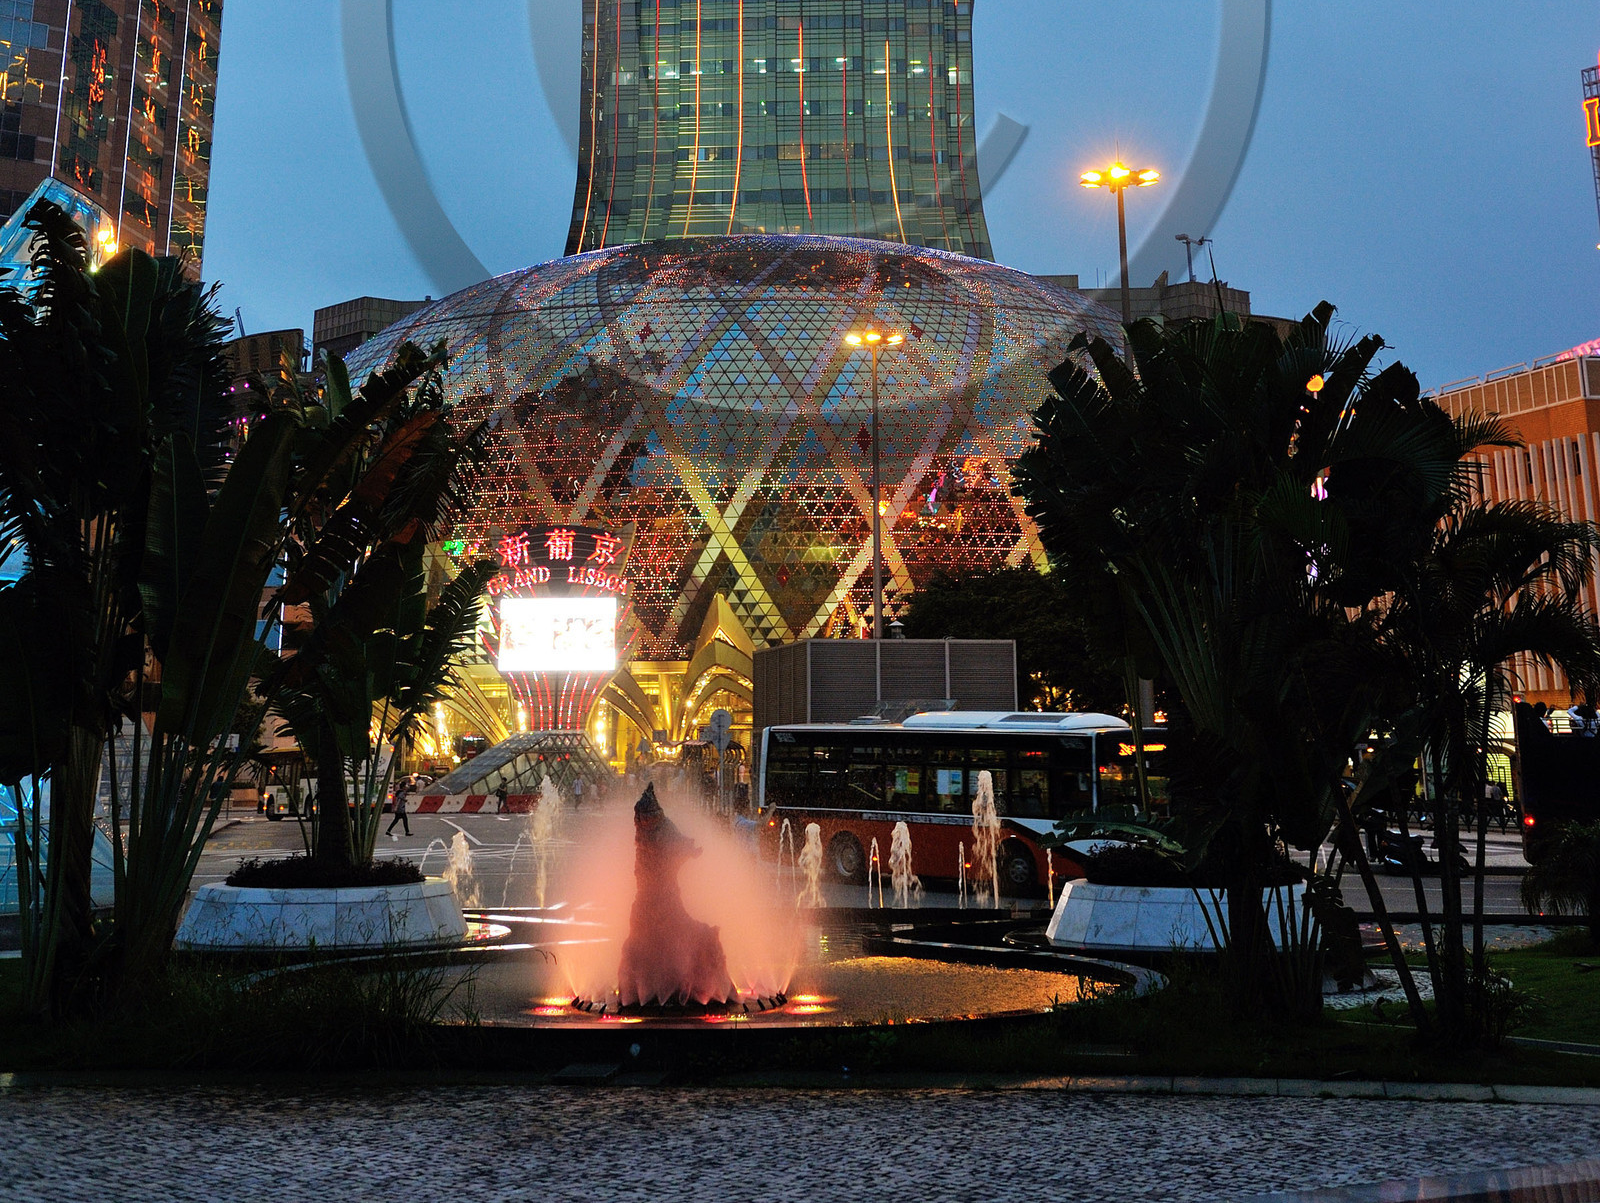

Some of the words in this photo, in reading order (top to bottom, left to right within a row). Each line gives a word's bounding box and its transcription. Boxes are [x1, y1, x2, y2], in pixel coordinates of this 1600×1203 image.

[496, 528, 623, 567] 新葡京
[486, 566, 551, 596] GRAND
[566, 566, 628, 595] LISBOA
